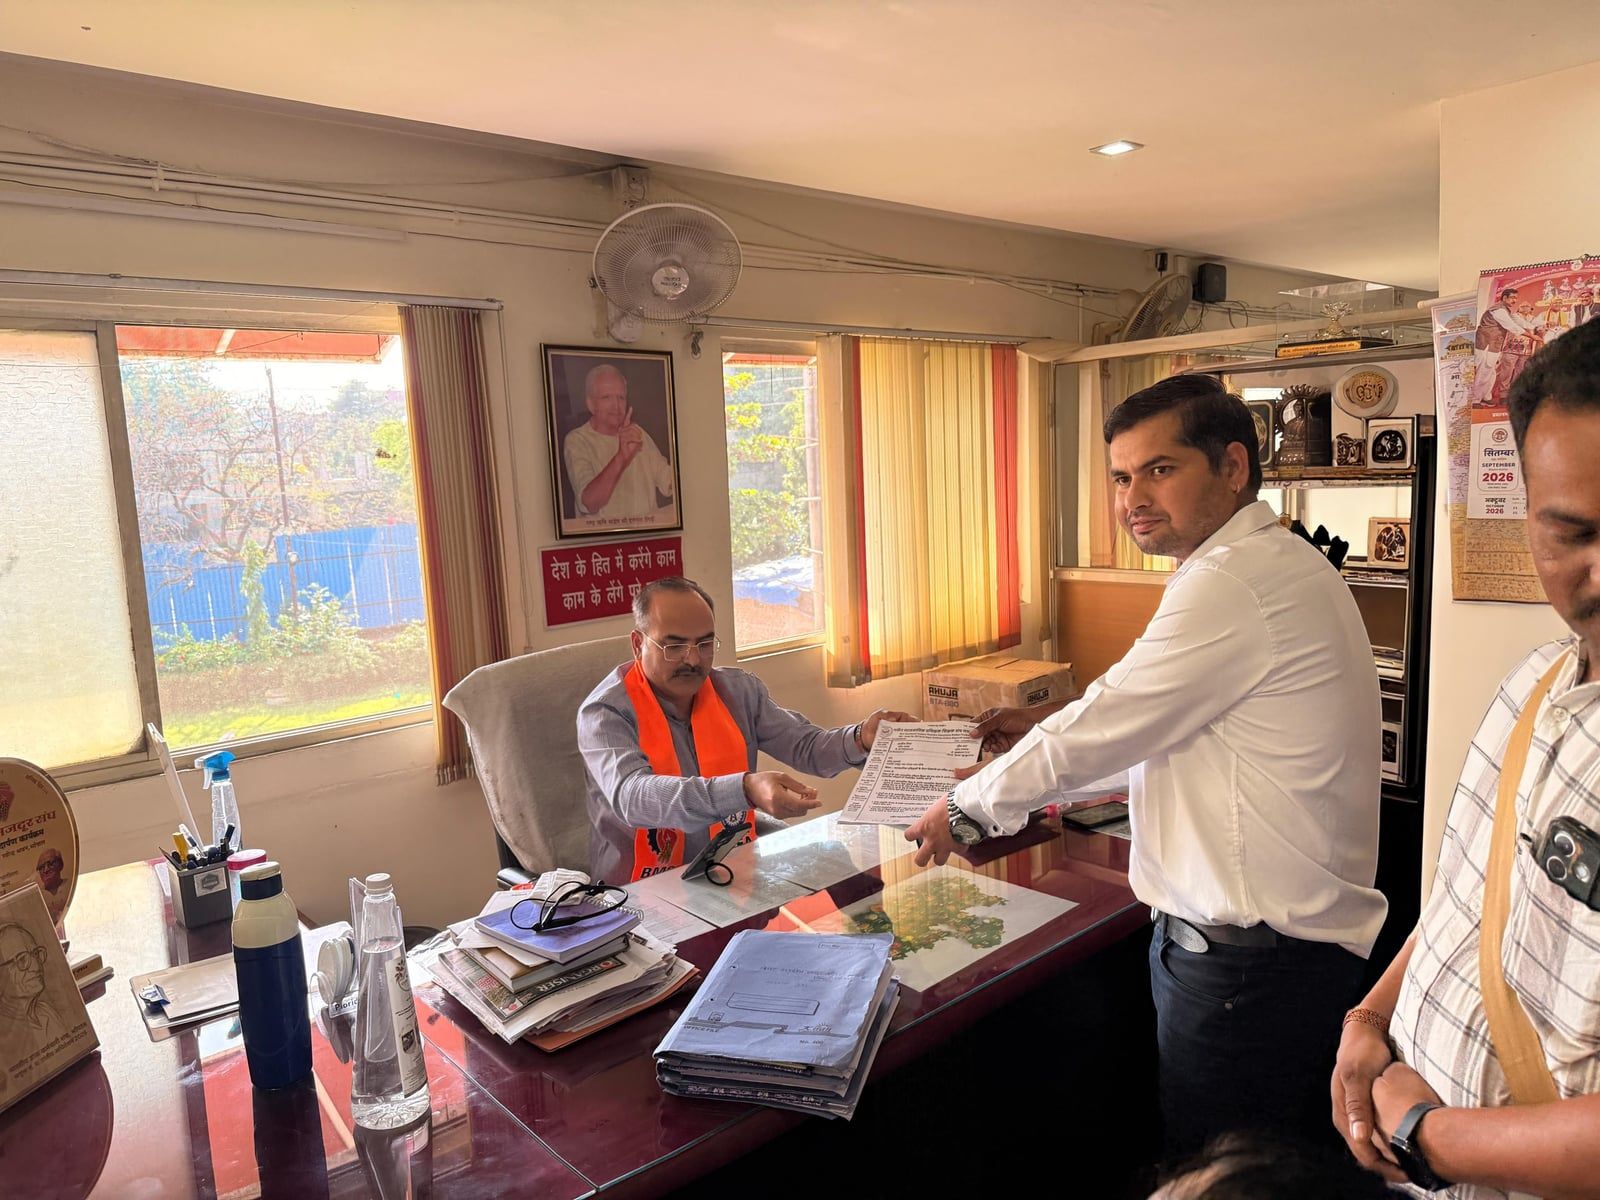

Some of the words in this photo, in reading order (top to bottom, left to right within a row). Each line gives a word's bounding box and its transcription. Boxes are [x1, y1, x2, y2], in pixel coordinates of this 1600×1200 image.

[1483, 447, 1516, 457] सितम्बर
[1482, 472, 1514, 482] 2026
[1484, 497, 1506, 505] अक्टूबर
[550, 556, 570, 581] देश
[575, 554, 586, 578] के
[591, 552, 611, 577] हित
[614, 548, 624, 573] में
[628, 546, 652, 570] करेंगे
[656, 549, 676, 567] काम
[562, 590, 585, 611] काम
[590, 583, 602, 607] के
[605, 580, 624, 604] लेंगे
[928, 686, 958, 698] AHUJA
[1027, 689, 1049, 704] AHUJA
[35, 810, 57, 825] संघ
[537, 960, 614, 992] ORGANISER
